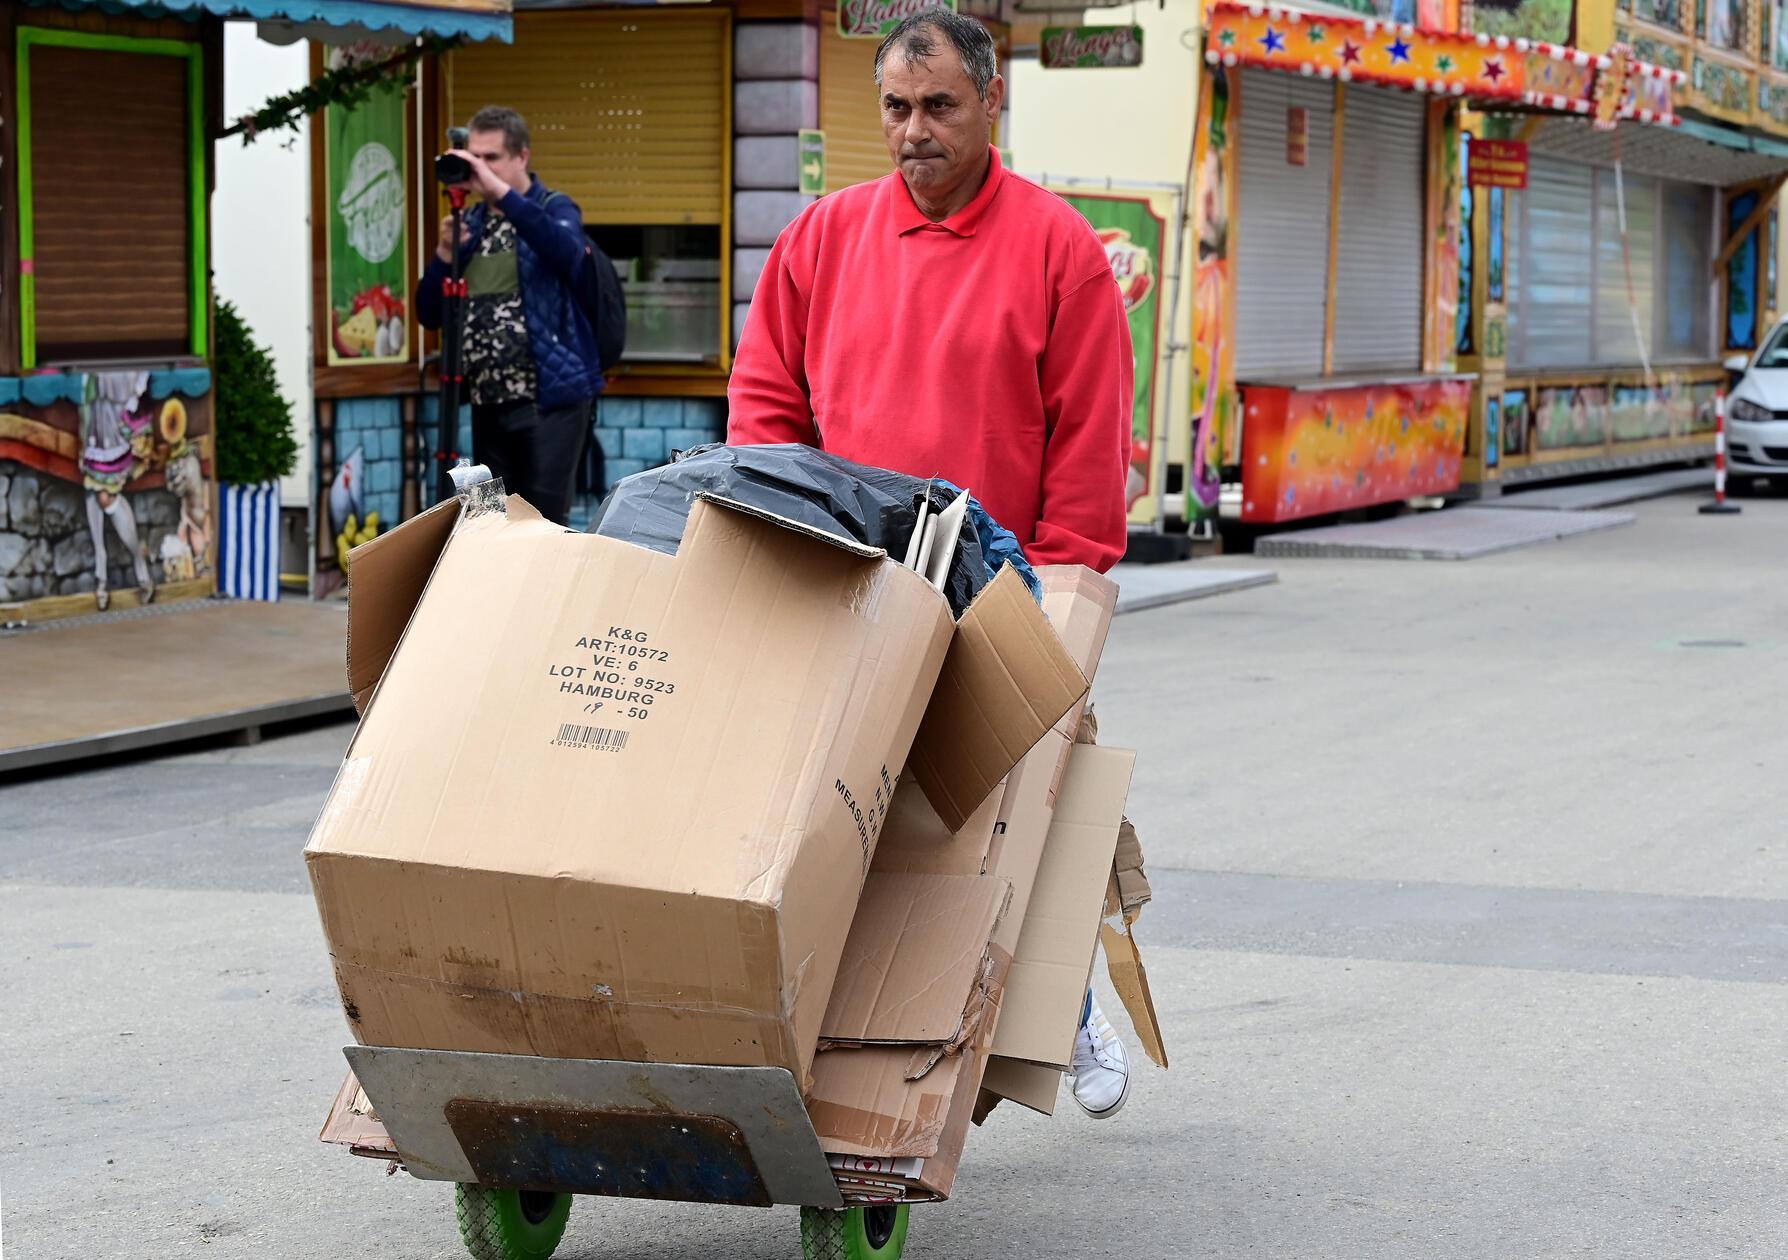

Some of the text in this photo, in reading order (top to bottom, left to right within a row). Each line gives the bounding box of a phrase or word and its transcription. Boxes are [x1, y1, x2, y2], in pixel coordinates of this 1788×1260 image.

[607, 626, 648, 643] K&G
[575, 636, 669, 663] ART:10572
[593, 654, 639, 671] VE: 6
[549, 664, 675, 694] LOT NO: 9523
[559, 681, 655, 705] HAMBURG
[557, 740, 587, 750] 012594
[590, 744, 621, 753] 105722
